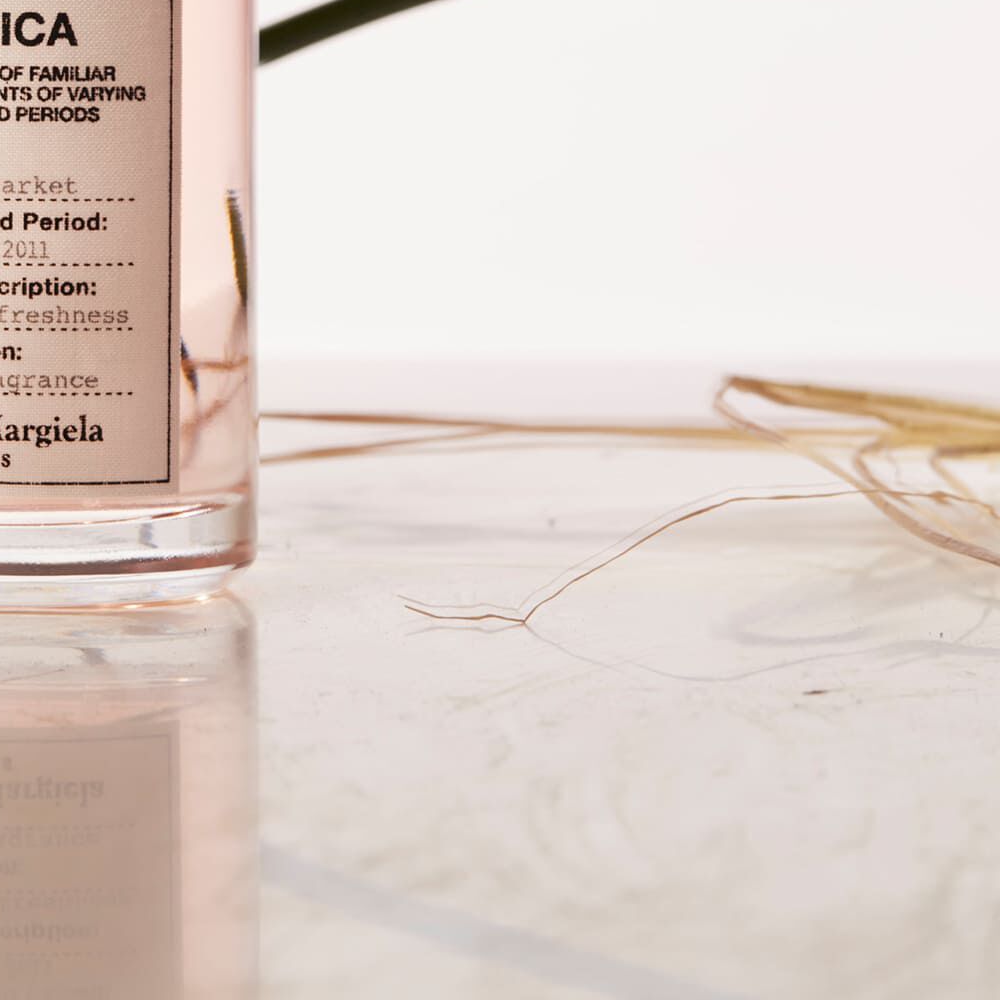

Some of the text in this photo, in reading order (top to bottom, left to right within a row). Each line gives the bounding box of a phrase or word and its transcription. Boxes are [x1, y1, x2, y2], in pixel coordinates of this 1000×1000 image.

[30, 66, 116, 82] FAMILIAR
[37, 87, 62, 101] OF
[67, 86, 146, 101] VARYING
[16, 107, 100, 123] PERIODS
[23, 213, 107, 231] Period:
[2, 240, 50, 259] 2011
